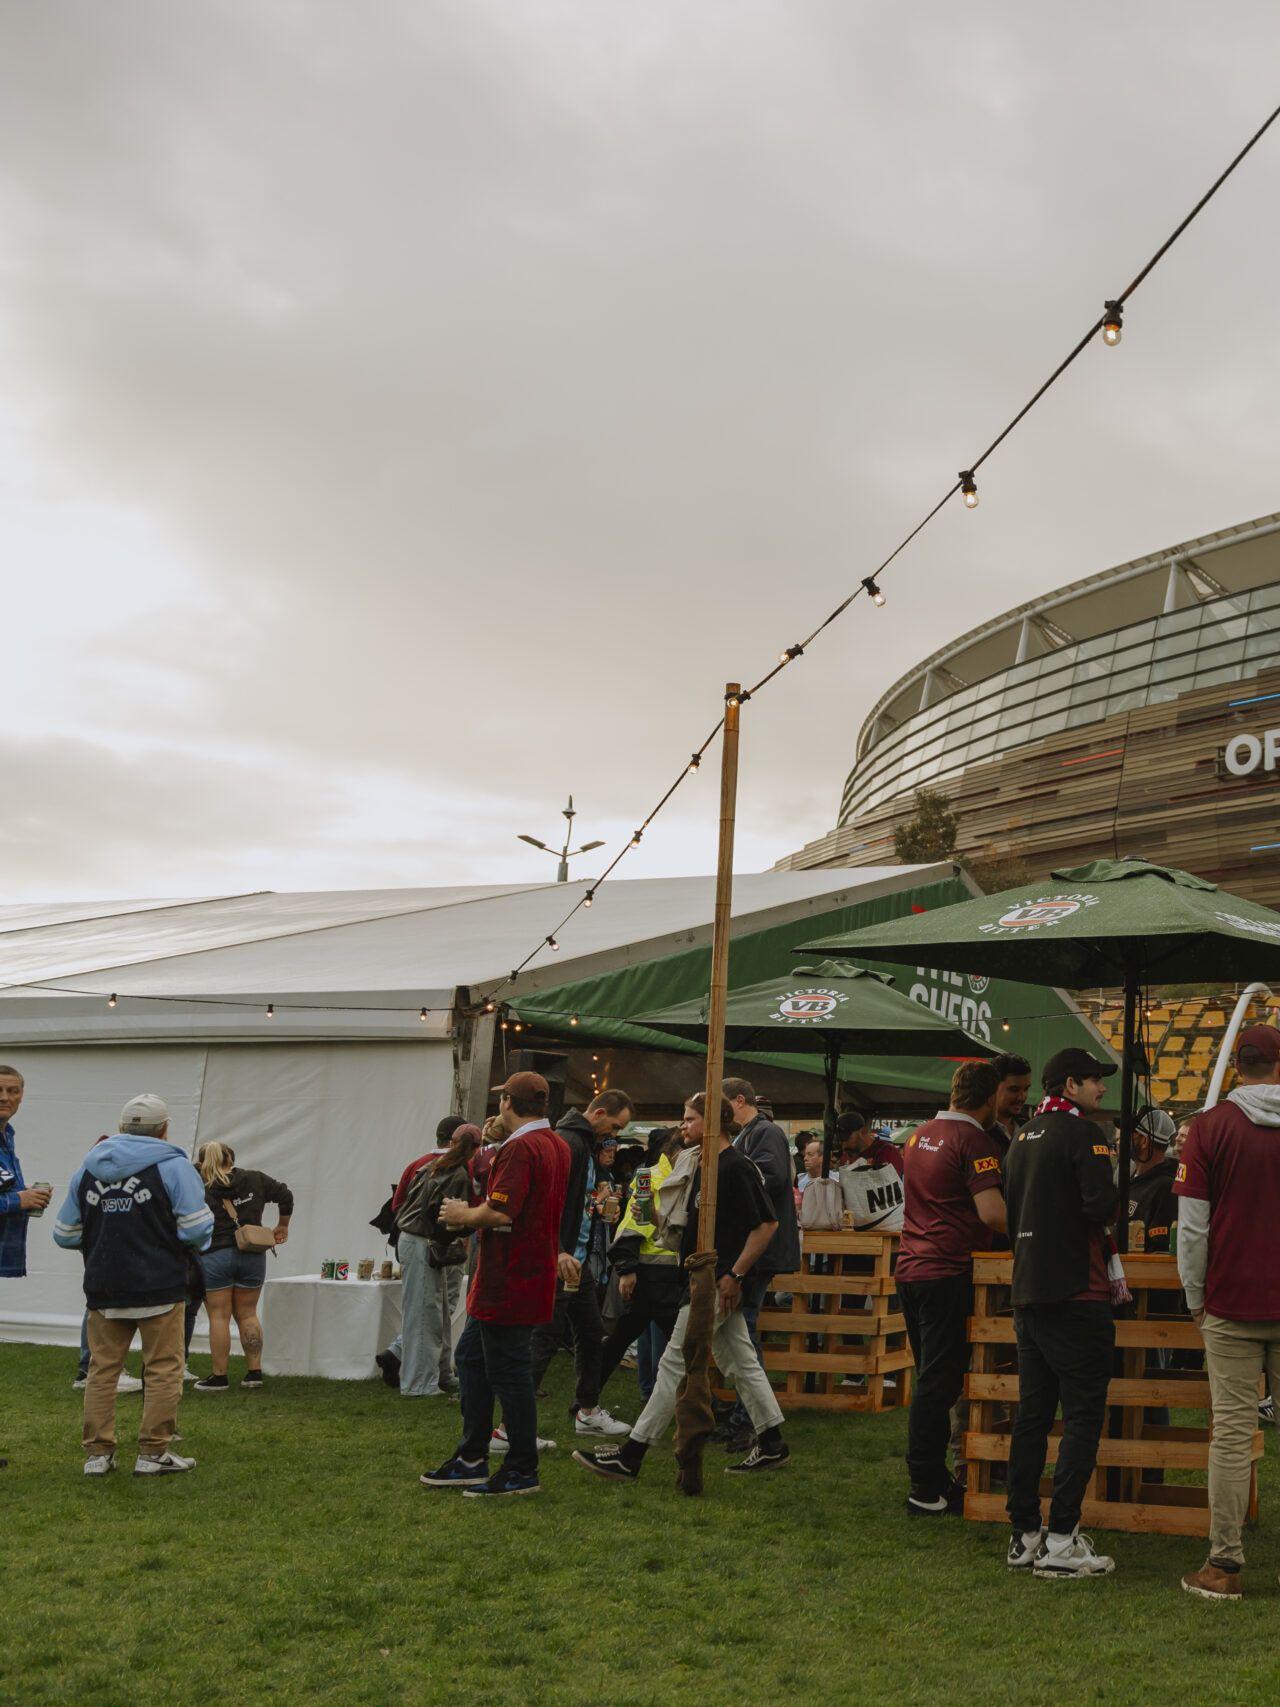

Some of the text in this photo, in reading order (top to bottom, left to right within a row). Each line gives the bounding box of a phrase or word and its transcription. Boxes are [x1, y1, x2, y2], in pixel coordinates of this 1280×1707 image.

[1005, 893, 1100, 908] VICTORIA
[978, 919, 1061, 935] BITTER
[775, 988, 850, 1003] VICTORIA
[789, 1000, 830, 1012] VB
[768, 1013, 836, 1025] BITTER
[101, 1198, 133, 1213] NSW
